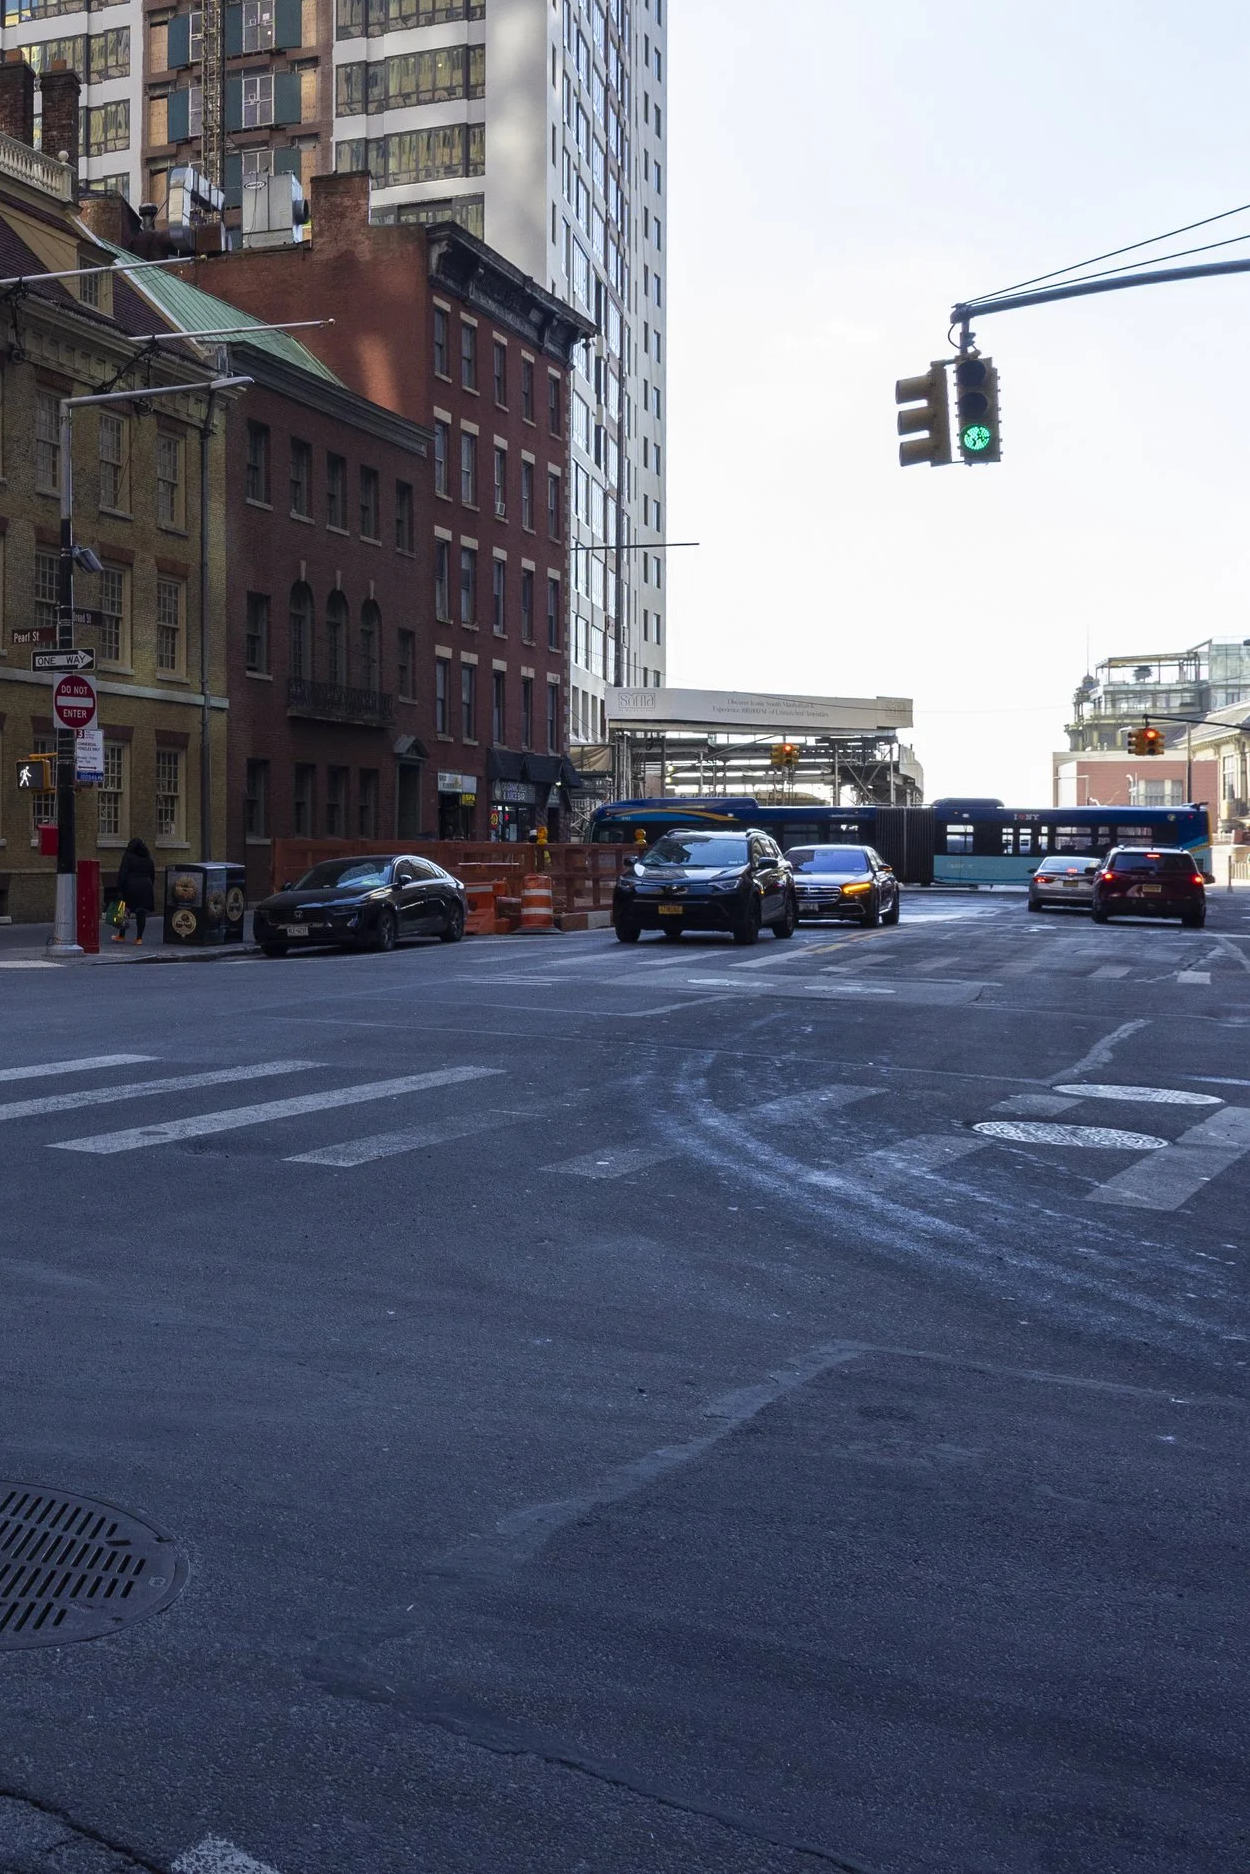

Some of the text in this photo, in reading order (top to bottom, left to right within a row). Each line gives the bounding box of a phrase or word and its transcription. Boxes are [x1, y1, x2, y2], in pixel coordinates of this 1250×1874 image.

[13, 631, 40, 643] Pearl St
[37, 655, 86, 666] ONE WAY
[61, 685, 88, 695] DO NOT
[63, 708, 87, 719] ENTER
